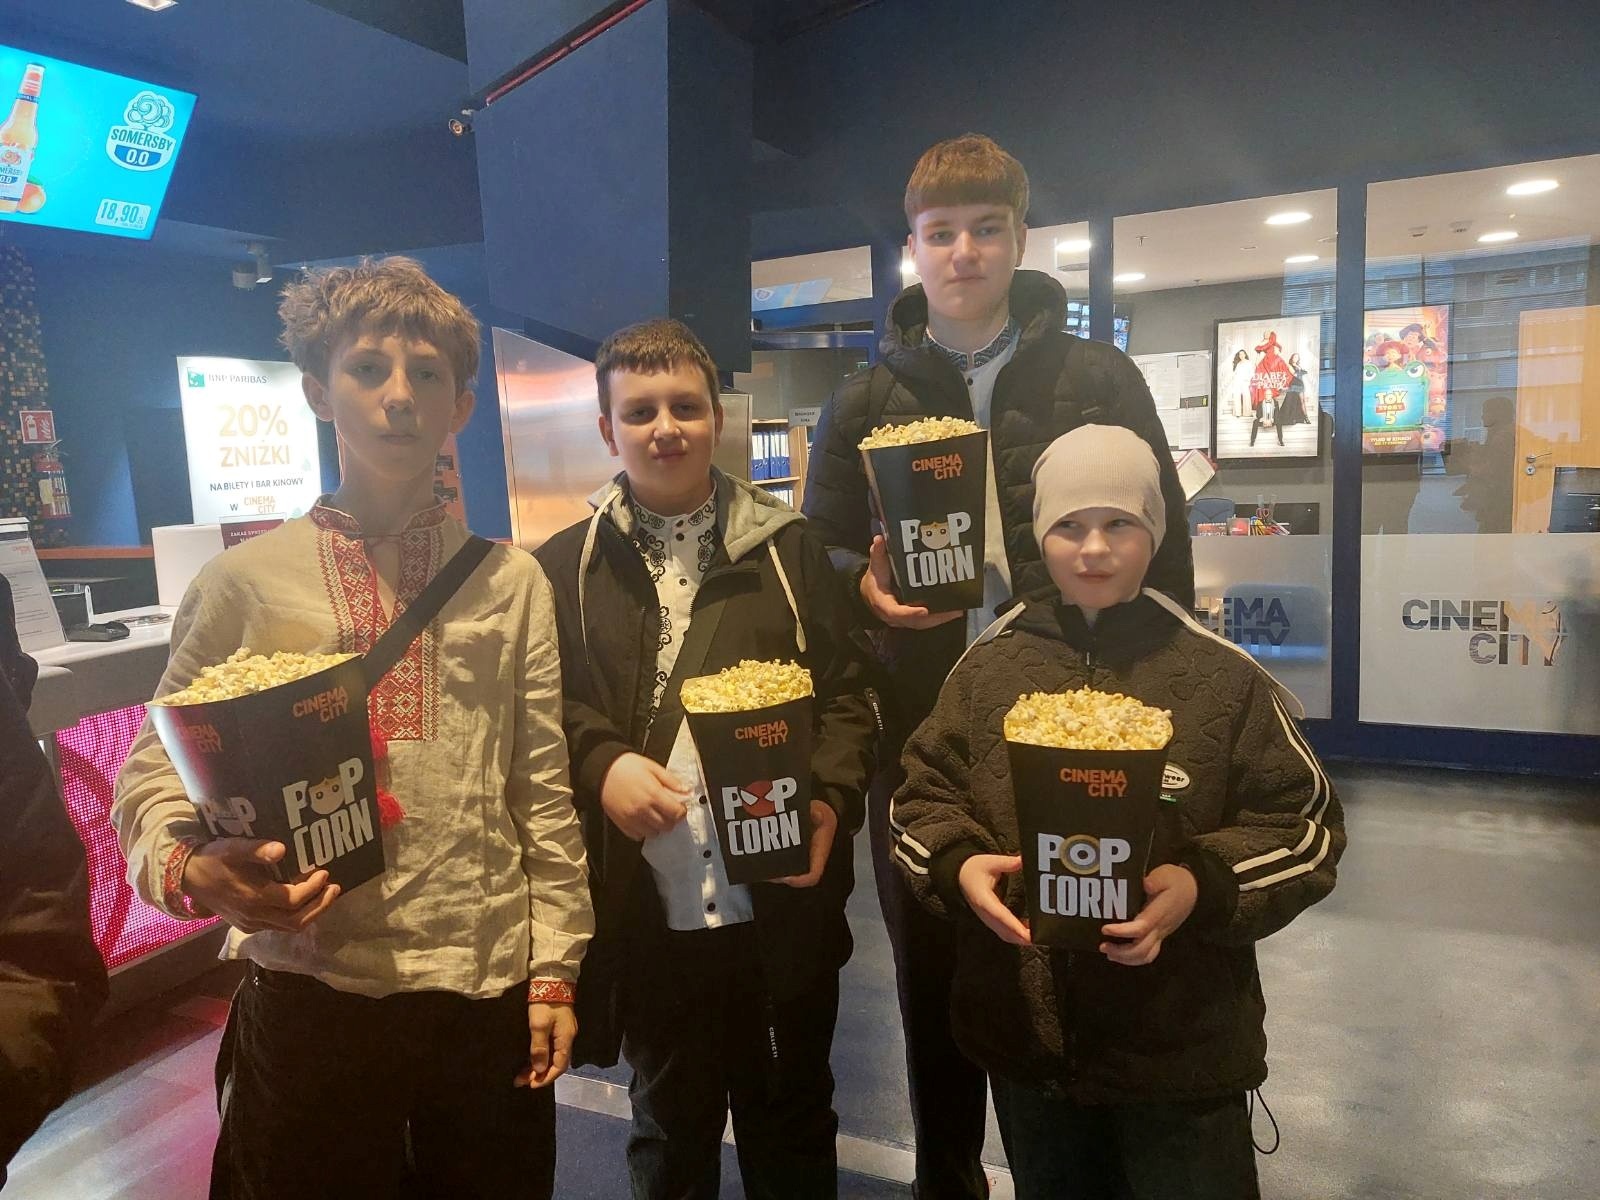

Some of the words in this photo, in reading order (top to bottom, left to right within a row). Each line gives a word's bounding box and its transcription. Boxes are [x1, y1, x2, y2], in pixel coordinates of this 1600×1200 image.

[111, 129, 173, 151] SOMERSBY
[101, 201, 139, 224] 18,90
[229, 374, 268, 384] PARIBAS
[1375, 390, 1408, 405] TOY
[218, 404, 288, 437] 20%
[1385, 410, 1396, 425] 5
[912, 453, 963, 473] CINEMA
[934, 465, 963, 480] CITY
[210, 483, 222, 492] NA
[223, 481, 249, 491] BILETY
[256, 480, 271, 488] BAR
[273, 477, 304, 487] KINOWY
[230, 503, 238, 511] W
[244, 495, 276, 506] CINEMA
[258, 504, 275, 514] CITY
[906, 545, 975, 588] CORN
[292, 686, 348, 718] CINEMA
[320, 701, 348, 723] CITY
[735, 720, 788, 740] CINEMA
[759, 730, 788, 748] CITY
[1059, 768, 1127, 784] CINEMA
[1088, 783, 1127, 798] CITY
[294, 798, 374, 874] CORN
[727, 810, 800, 856] CORN
[1037, 832, 1131, 877] POP
[1040, 873, 1128, 920] CORN
